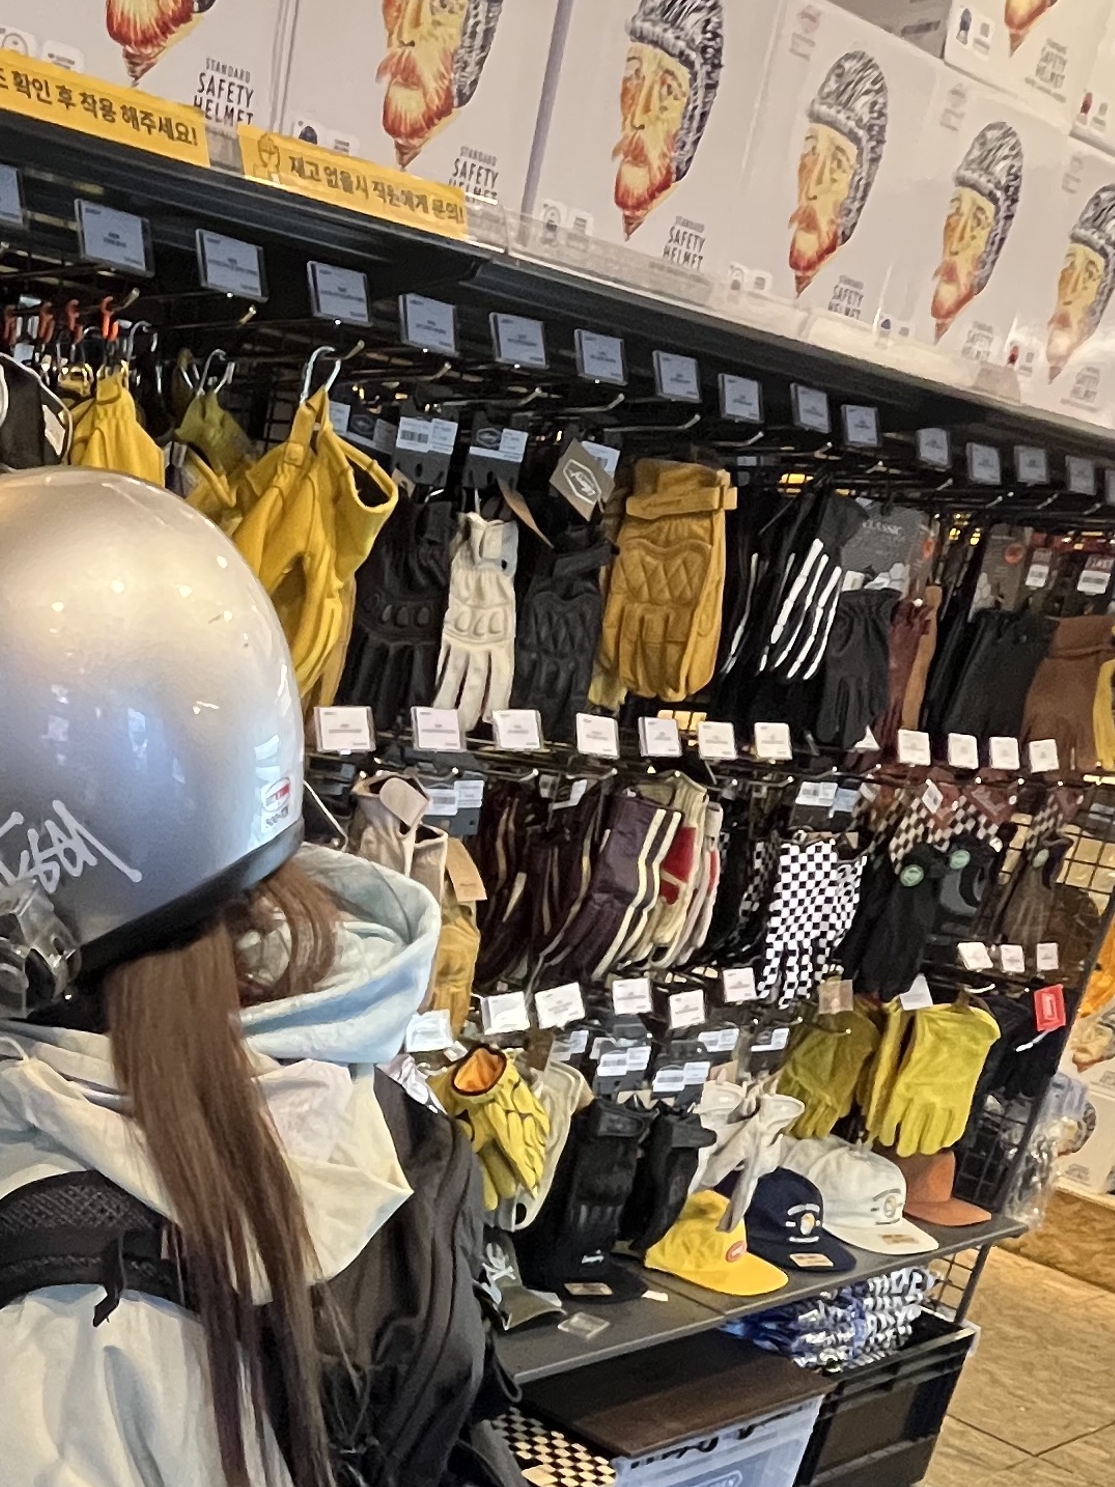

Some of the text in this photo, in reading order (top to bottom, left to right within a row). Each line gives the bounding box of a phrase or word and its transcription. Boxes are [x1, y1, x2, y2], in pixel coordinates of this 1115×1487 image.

[206, 57, 251, 83] STANDARD
[197, 72, 254, 108] SAFETY
[11, 70, 52, 105] 확인
[55, 84, 76, 110] 후
[79, 92, 117, 123] 착용
[120, 104, 198, 146] 해주세요!
[193, 95, 254, 126] HELMET
[289, 155, 322, 183] 재고
[451, 158, 499, 188] SAFETY
[667, 225, 706, 253] SAFETY
